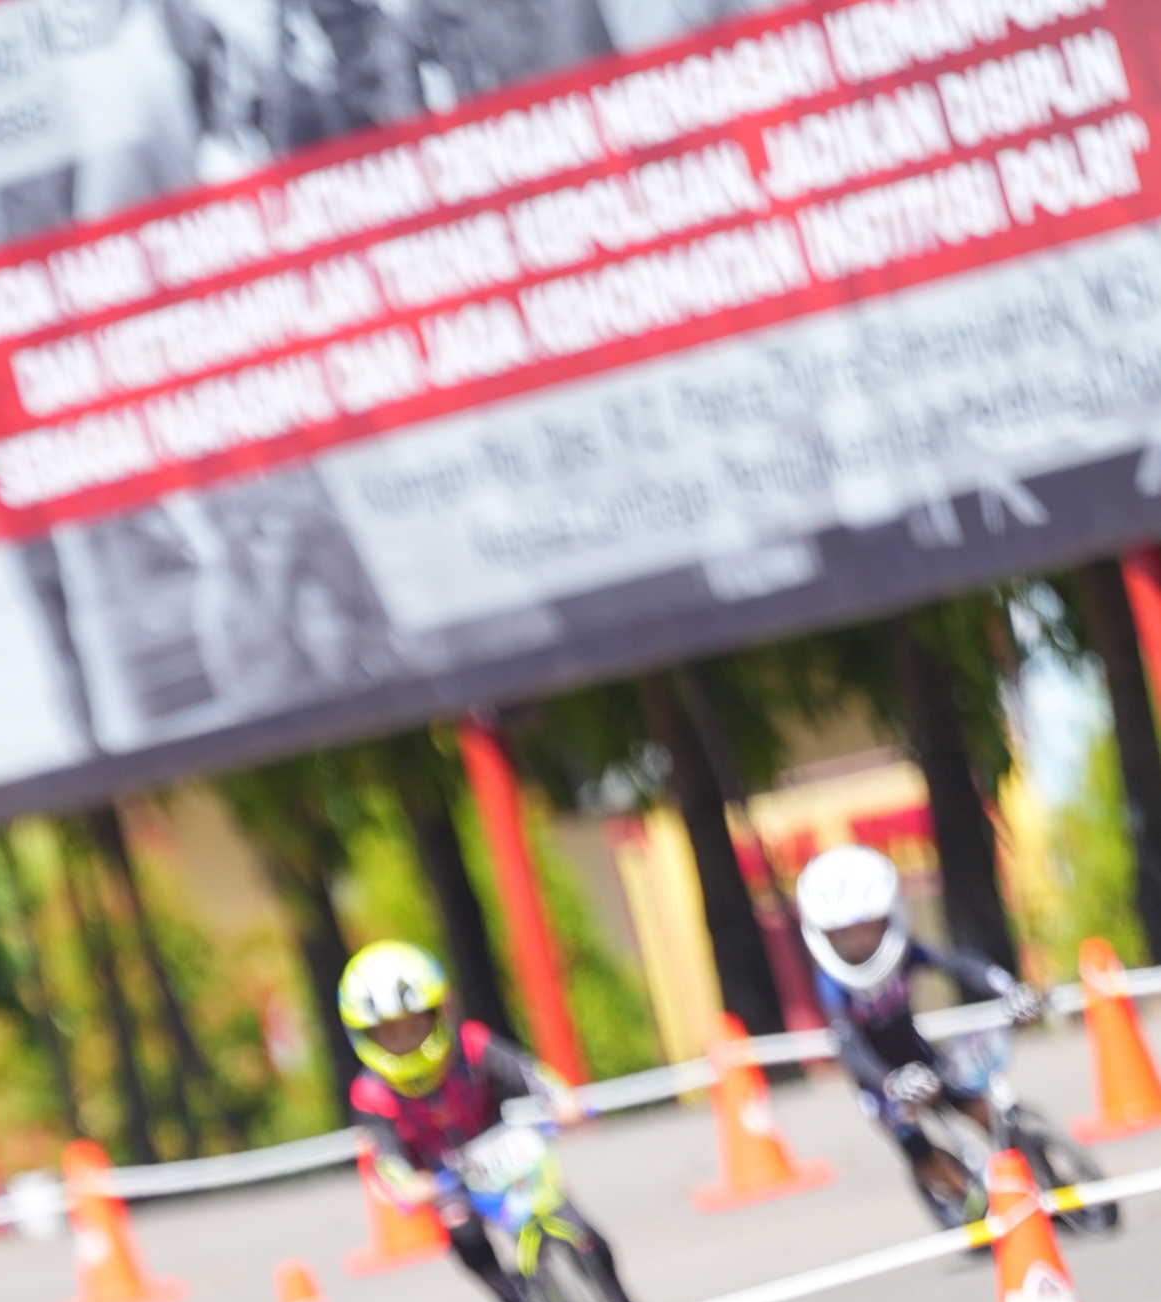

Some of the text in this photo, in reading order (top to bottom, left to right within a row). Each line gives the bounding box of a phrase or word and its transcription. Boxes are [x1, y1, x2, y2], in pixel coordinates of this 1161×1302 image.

[15, 340, 103, 414] DAN
[95, 257, 380, 388] KETERAMPILAN
[368, 213, 520, 305] TEKNIS
[764, 87, 948, 199] JADIKAN
[939, 31, 1128, 145] DISIPLIN
[52, 235, 150, 312] HARI
[140, 201, 269, 283] TANPA
[261, 149, 433, 251] LATIHAN
[423, 97, 604, 202] DENGAN
[593, 26, 832, 148] MENGASAH
[324, 331, 421, 411] DAN
[417, 303, 531, 386] JAGA
[523, 221, 807, 353] KEHORMATAN
[799, 162, 1006, 277] INSTITUSI
